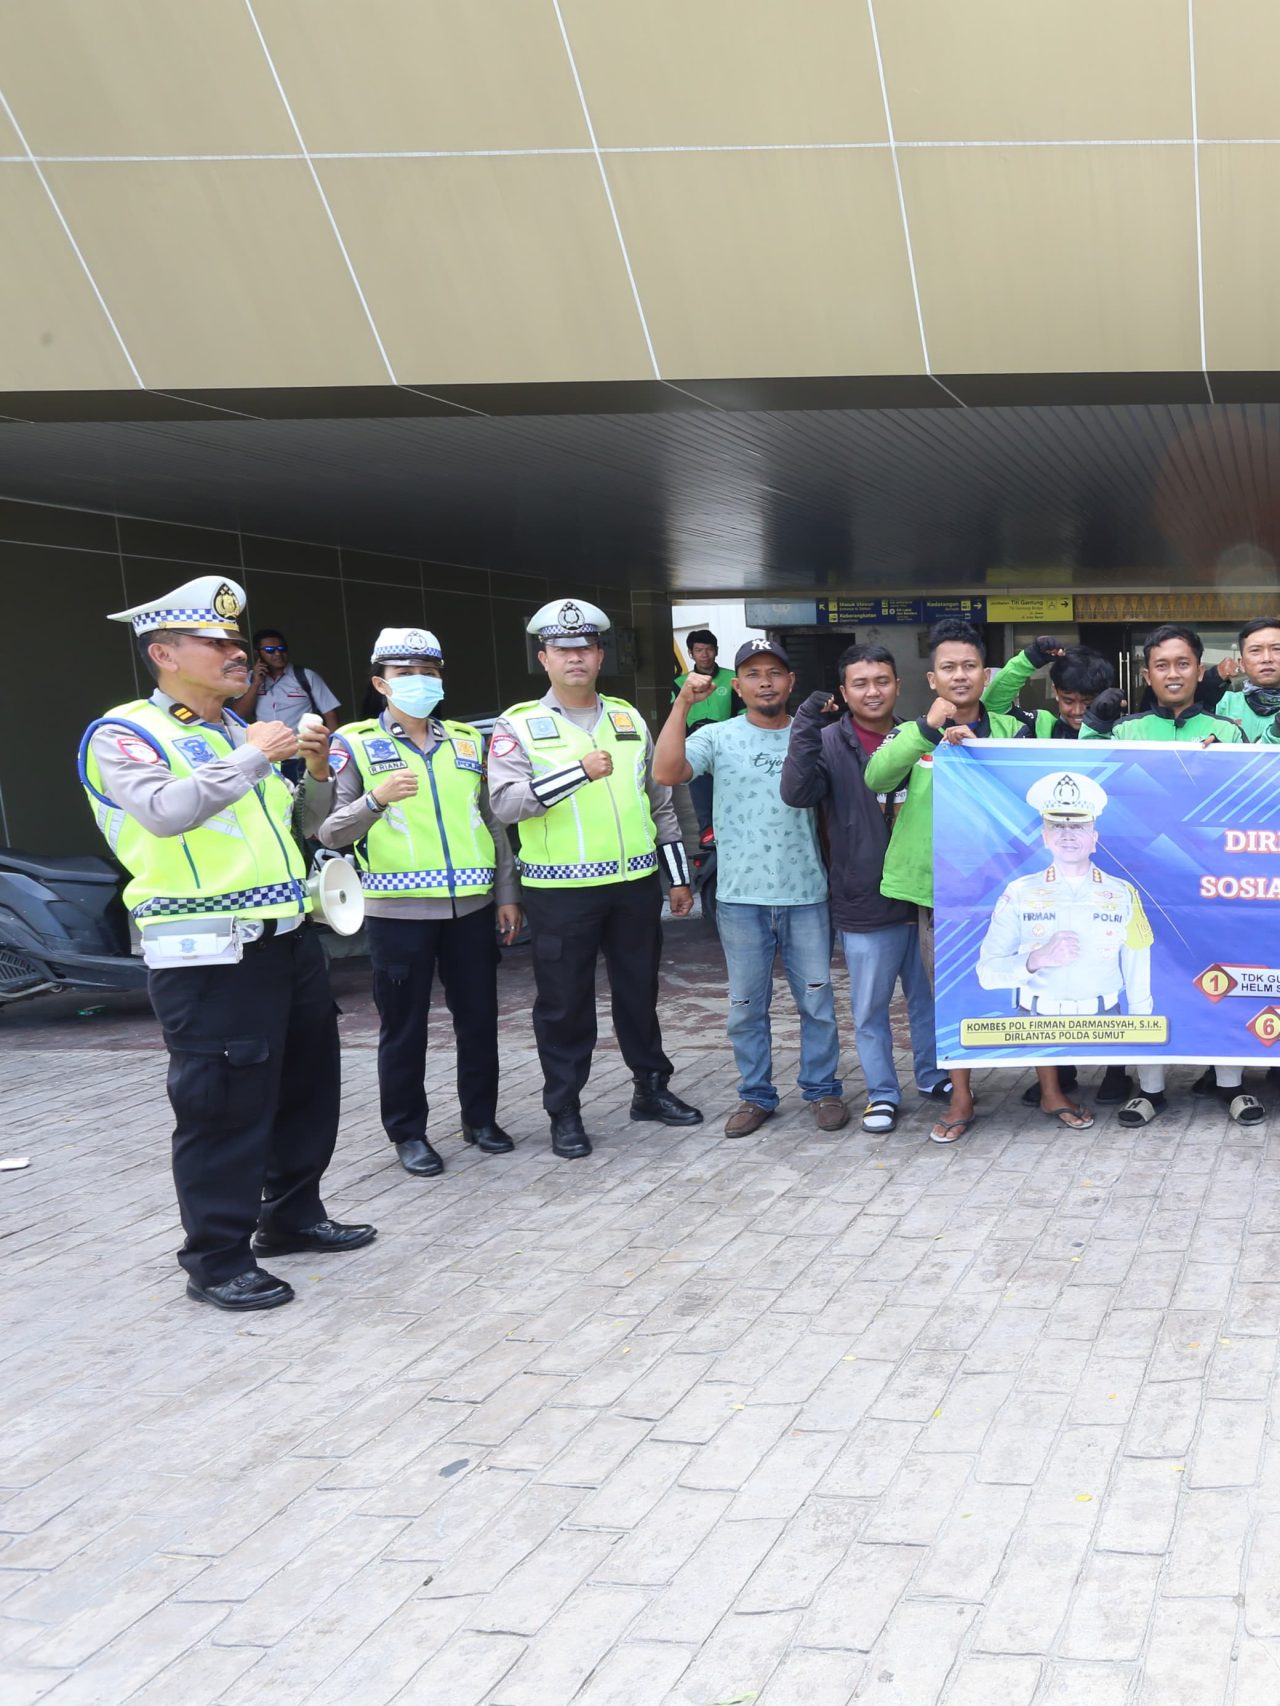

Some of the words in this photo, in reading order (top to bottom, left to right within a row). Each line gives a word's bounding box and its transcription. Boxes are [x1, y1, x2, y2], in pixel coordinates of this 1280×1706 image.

[1023, 912, 1056, 922] FIRMAN
[1093, 912, 1122, 923] POLRI
[1209, 974, 1219, 991] 1
[1241, 973, 1264, 983] TDK
[1241, 983, 1273, 993] HELM
[967, 1022, 1006, 1032] KOMBES
[1009, 1022, 1027, 1030] POL
[1029, 1021, 1066, 1029] FIRMAN
[1068, 1020, 1137, 1030] DARMANSYAH,
[1140, 1020, 1162, 1029] S.I.K.
[1262, 1018, 1275, 1035] 6
[1004, 1032, 1056, 1041] DIRLANTAS
[1059, 1031, 1089, 1040] POLDA
[1093, 1031, 1125, 1039] SUMUT
